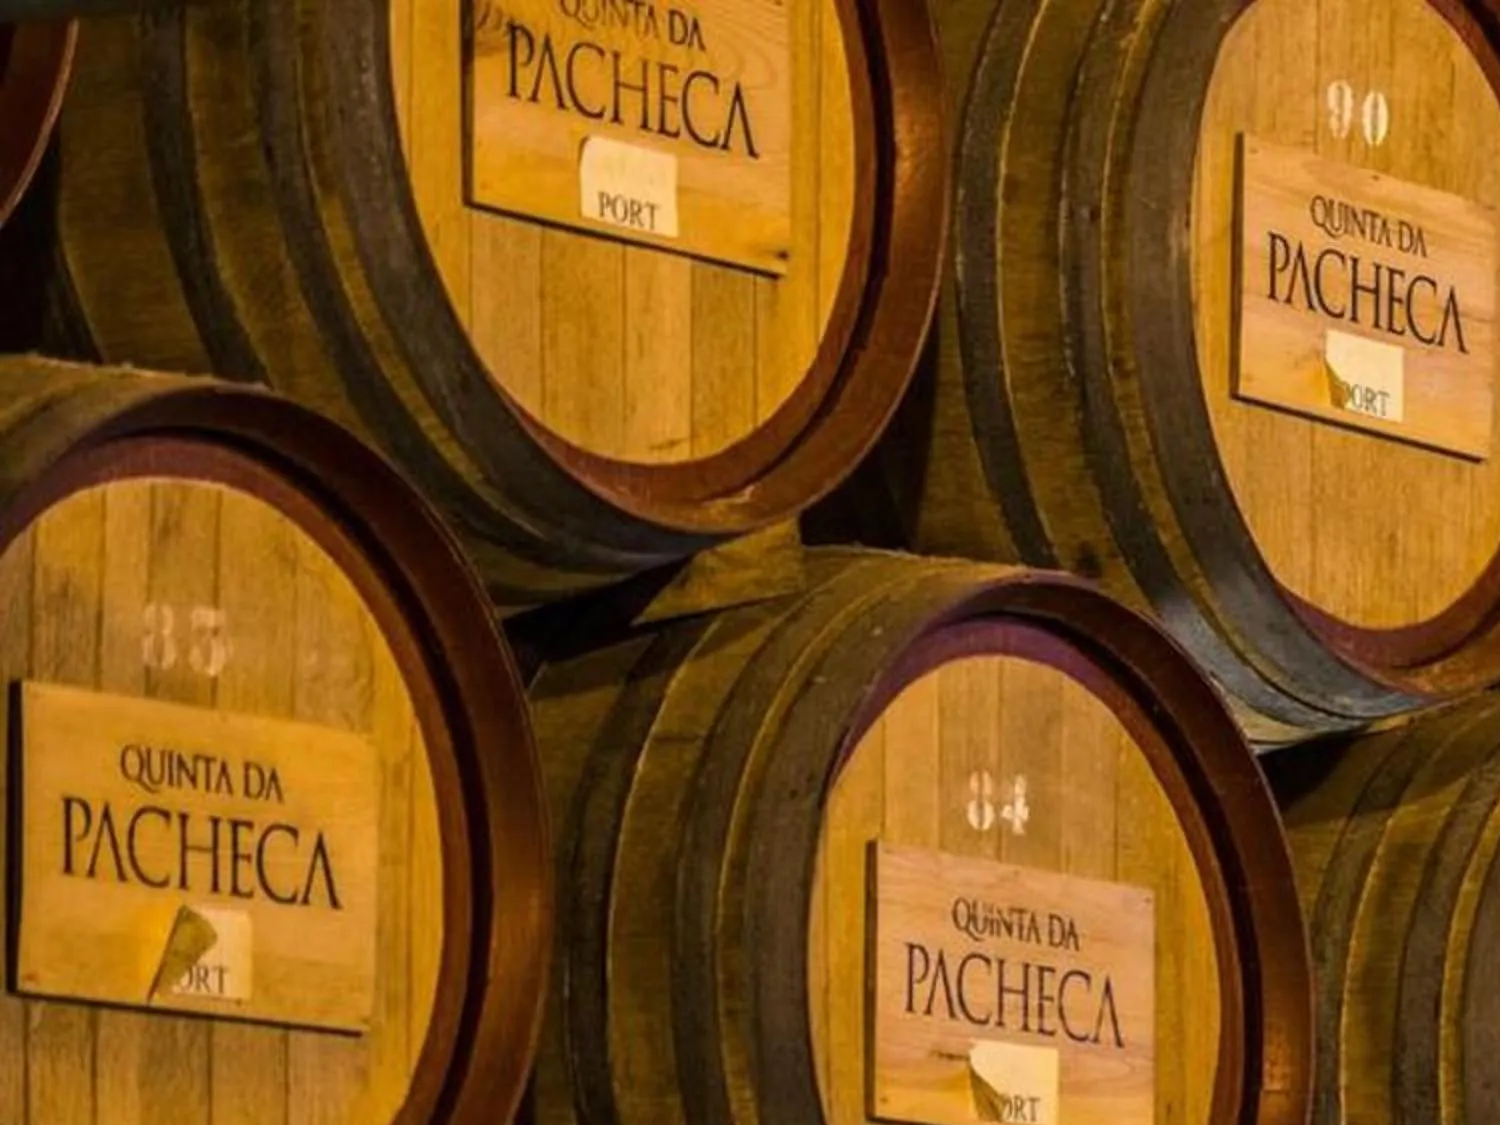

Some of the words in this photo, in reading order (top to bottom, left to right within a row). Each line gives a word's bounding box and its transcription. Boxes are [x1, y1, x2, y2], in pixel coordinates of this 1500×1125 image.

[560, 0, 660, 39] QUINTA
[668, 9, 706, 52] DA
[506, 22, 760, 159] PACHECA
[1326, 79, 1389, 146] 90
[598, 191, 660, 230] PORT
[1310, 195, 1394, 248] QUINTA
[1397, 220, 1428, 258] DA
[1267, 231, 1470, 355] PACHECA
[120, 743, 234, 796] QUINTA
[243, 760, 286, 805] DA
[967, 771, 1030, 835] 84
[61, 794, 344, 910] PACHECA
[952, 897, 1041, 945] QUINTA
[1047, 914, 1081, 952] DA
[180, 963, 231, 994] ORT
[904, 942, 1125, 1049] PACHECA
[1001, 1093, 1041, 1122] ORT
